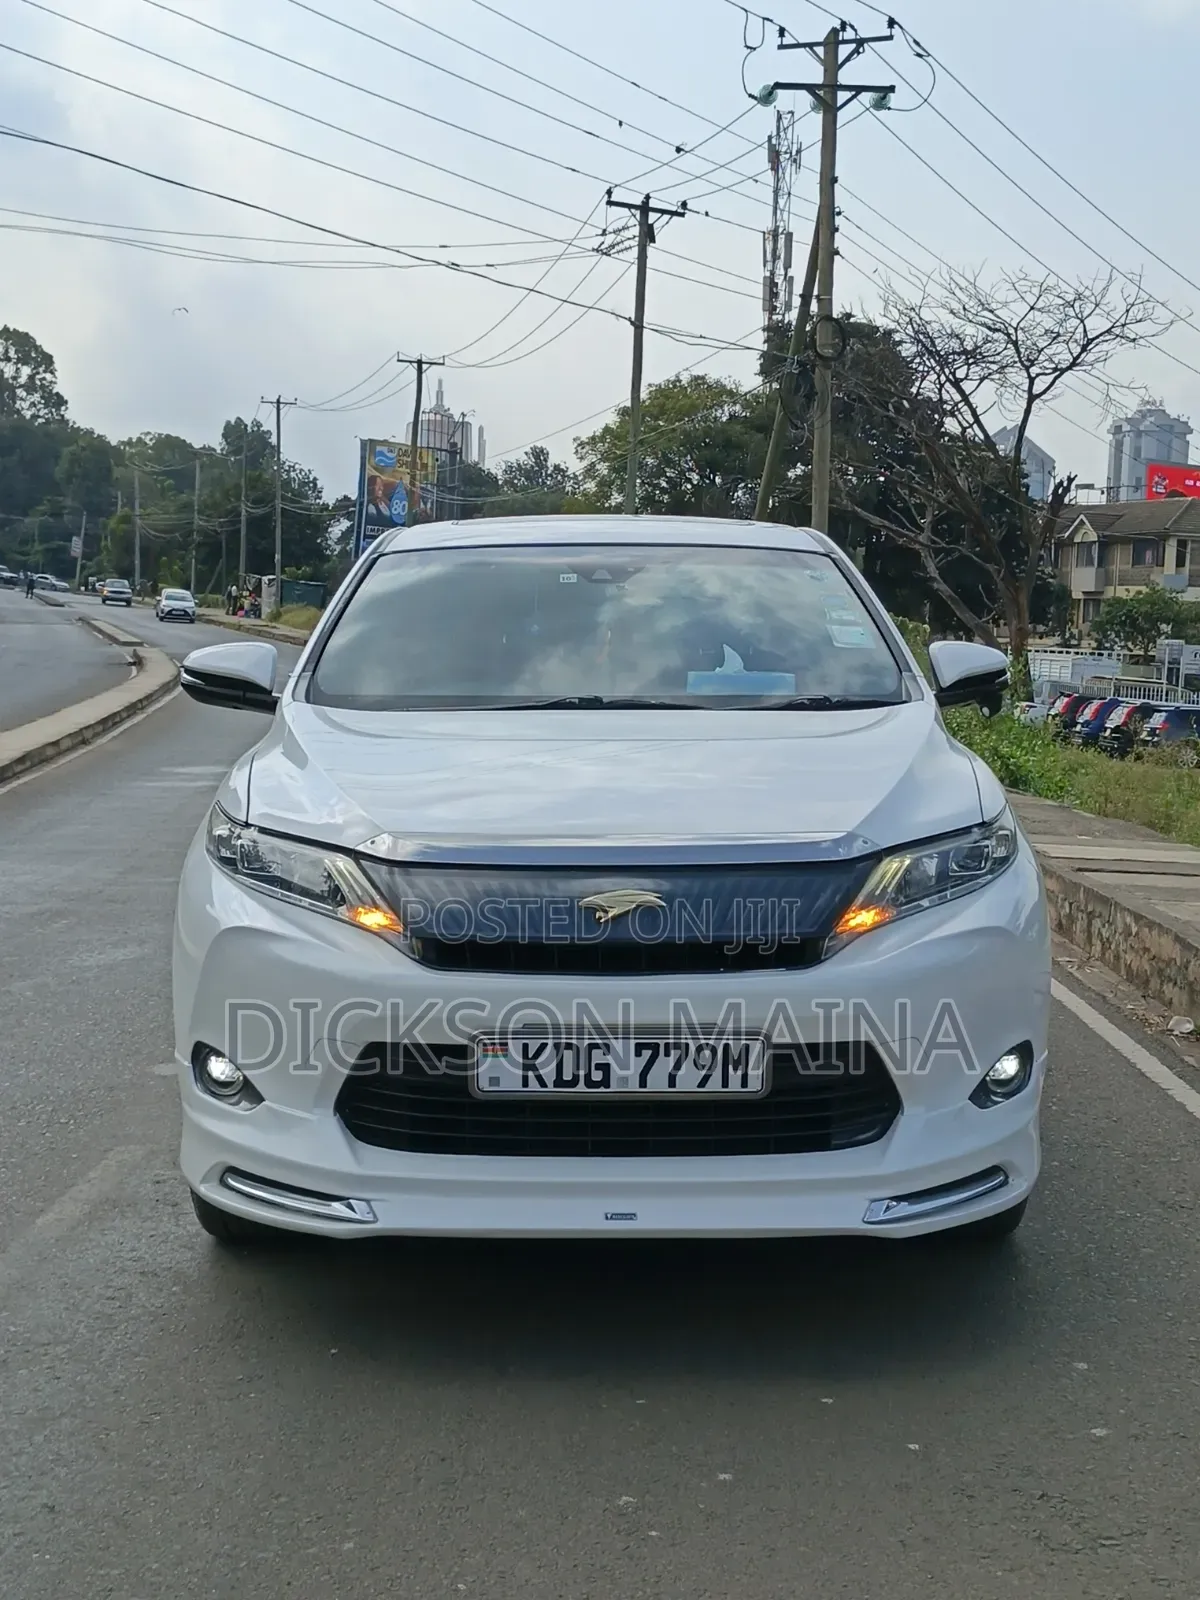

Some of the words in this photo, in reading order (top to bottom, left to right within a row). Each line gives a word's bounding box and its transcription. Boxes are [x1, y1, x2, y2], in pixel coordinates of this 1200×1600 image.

[392, 501, 408, 515] 80
[521, 1041, 612, 1089] KDG
[633, 1041, 749, 1089] 779M
